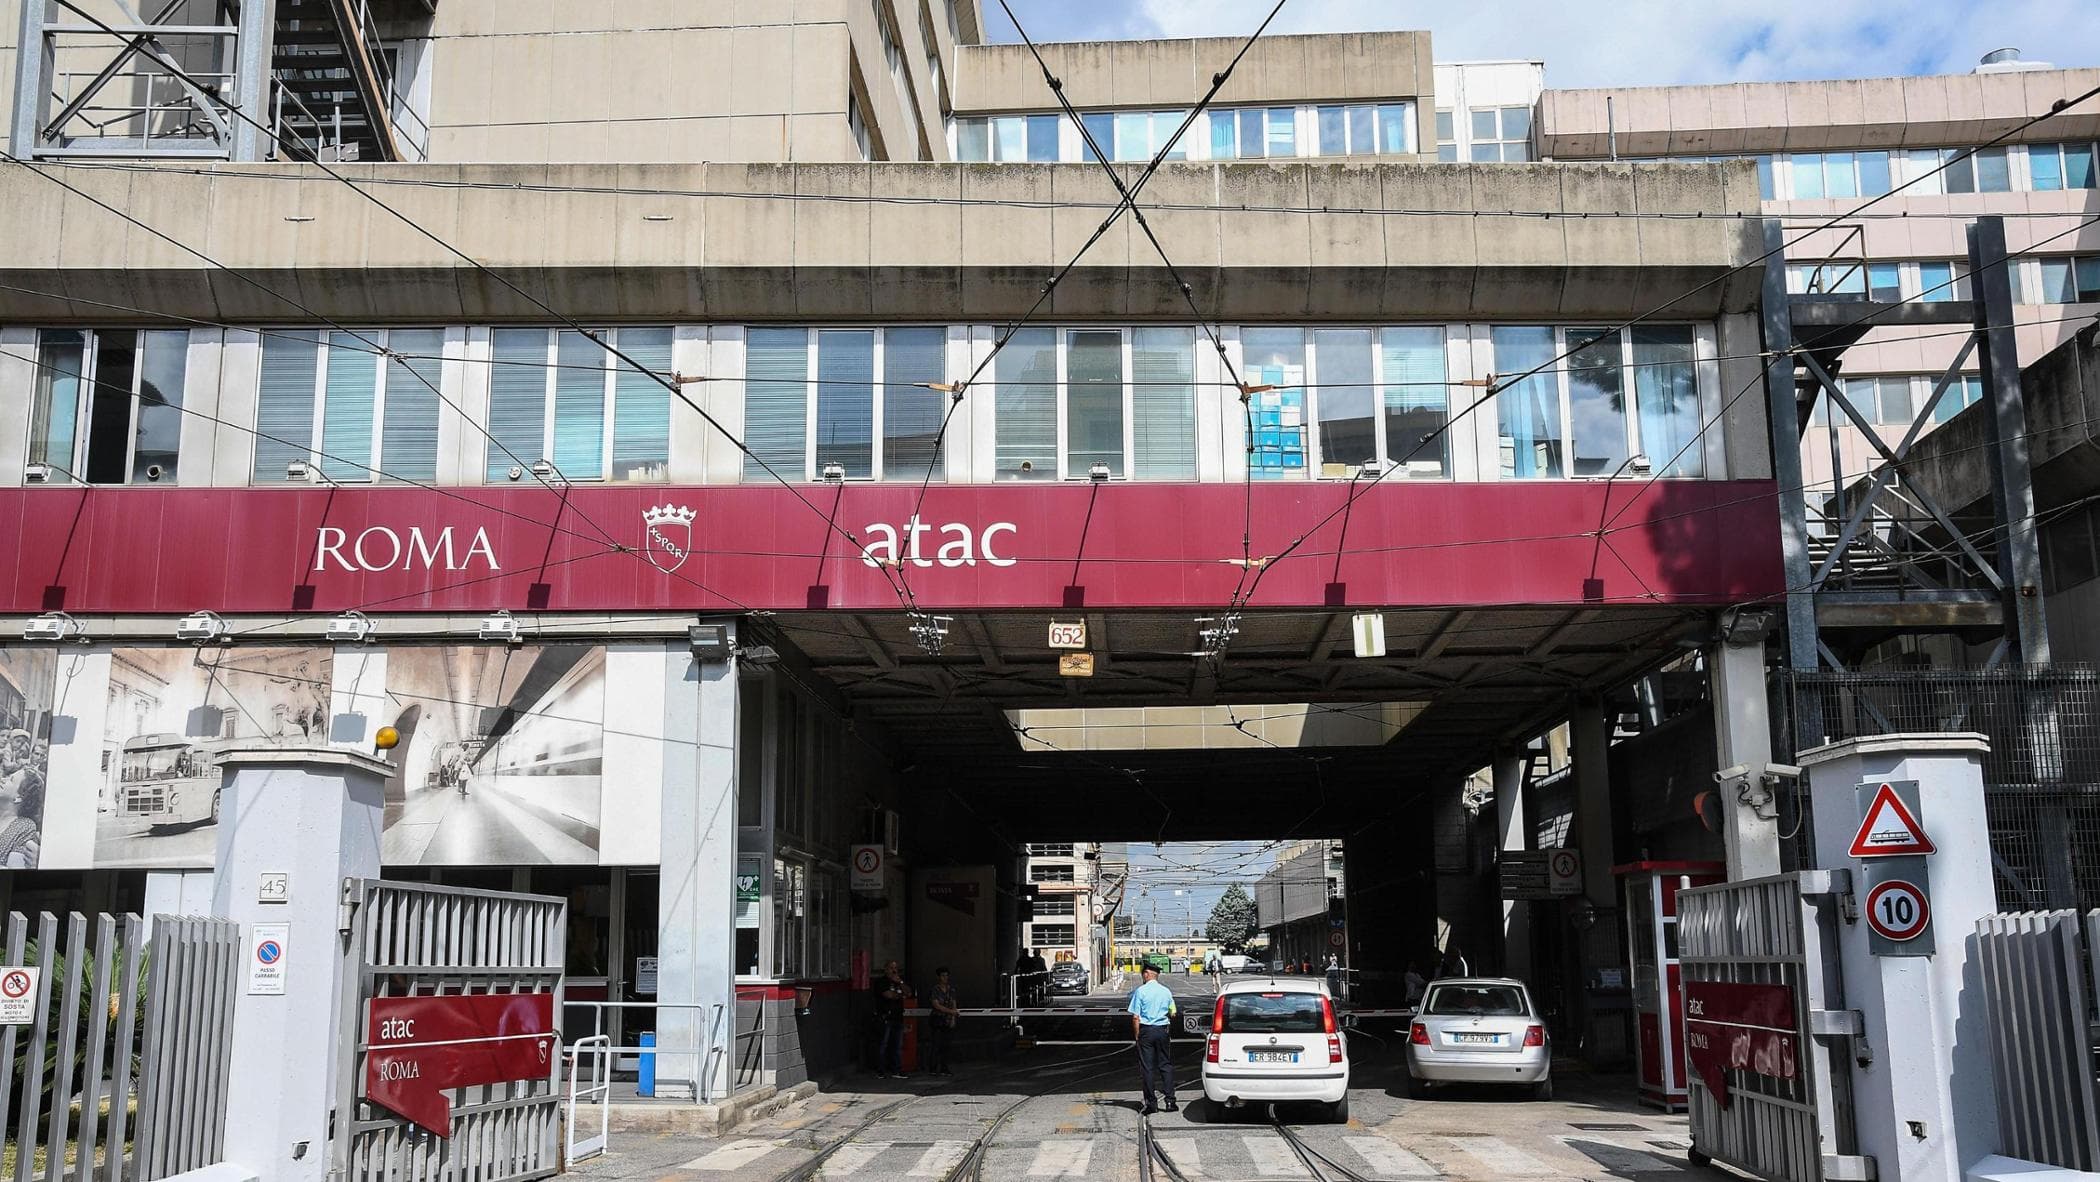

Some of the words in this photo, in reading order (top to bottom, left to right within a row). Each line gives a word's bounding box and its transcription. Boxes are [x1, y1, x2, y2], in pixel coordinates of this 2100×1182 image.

[313, 525, 501, 572] ROMA
[655, 533, 684, 558] SPQR
[862, 513, 1017, 568] atac
[1051, 627, 1084, 645] 652
[261, 879, 287, 894] 45
[1882, 895, 1914, 925] 10
[1689, 997, 1704, 1015] atac
[381, 1016, 415, 1040] atac
[380, 1060, 420, 1081] ROMA
